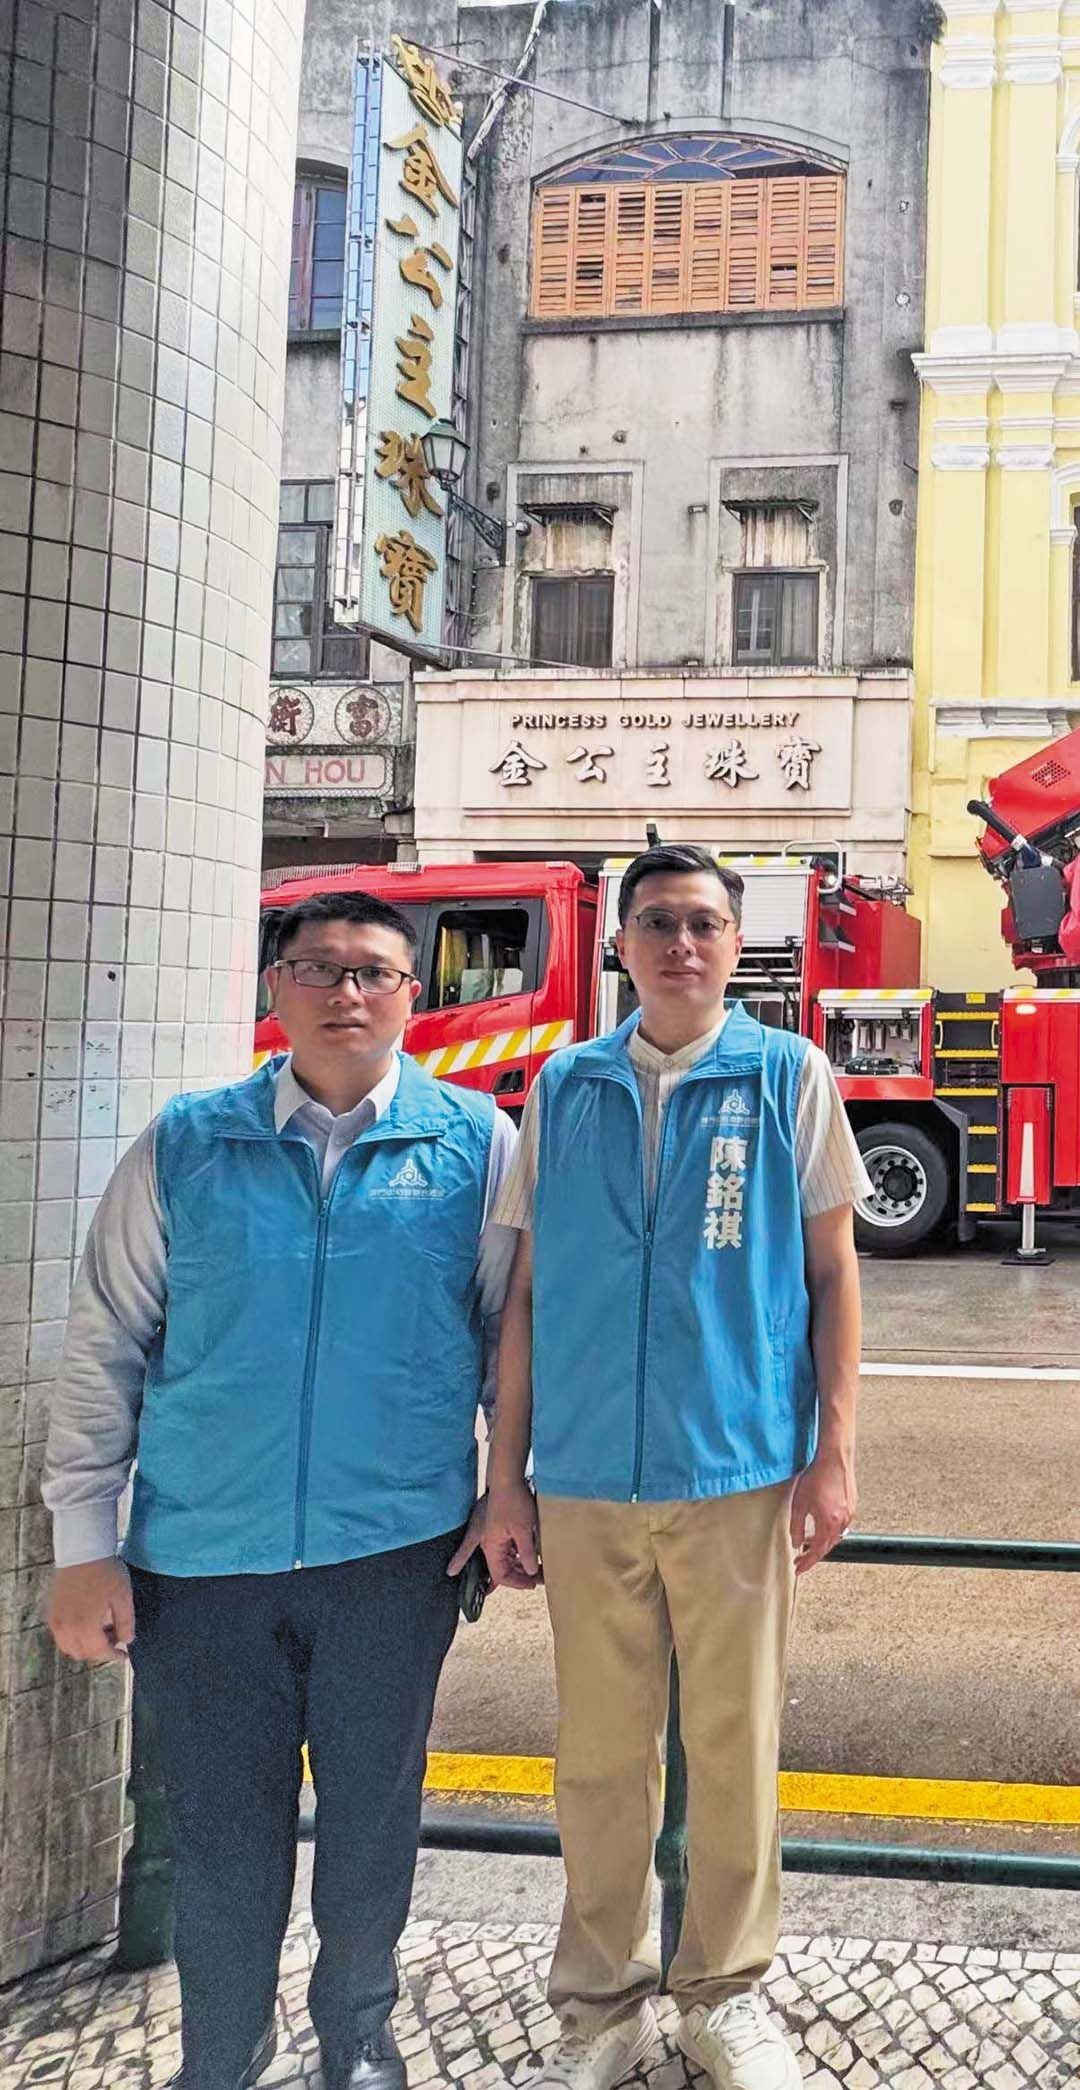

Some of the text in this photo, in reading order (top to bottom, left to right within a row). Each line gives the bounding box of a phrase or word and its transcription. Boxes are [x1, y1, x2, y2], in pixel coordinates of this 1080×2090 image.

[374, 121, 459, 634] 金公主珠寶
[511, 711, 801, 730] PRINCESS GOLD JEWELLERY
[305, 758, 366, 785] HOU
[488, 735, 823, 792] 金公主珠寶
[703, 1136, 748, 1251] 陳銘祺
